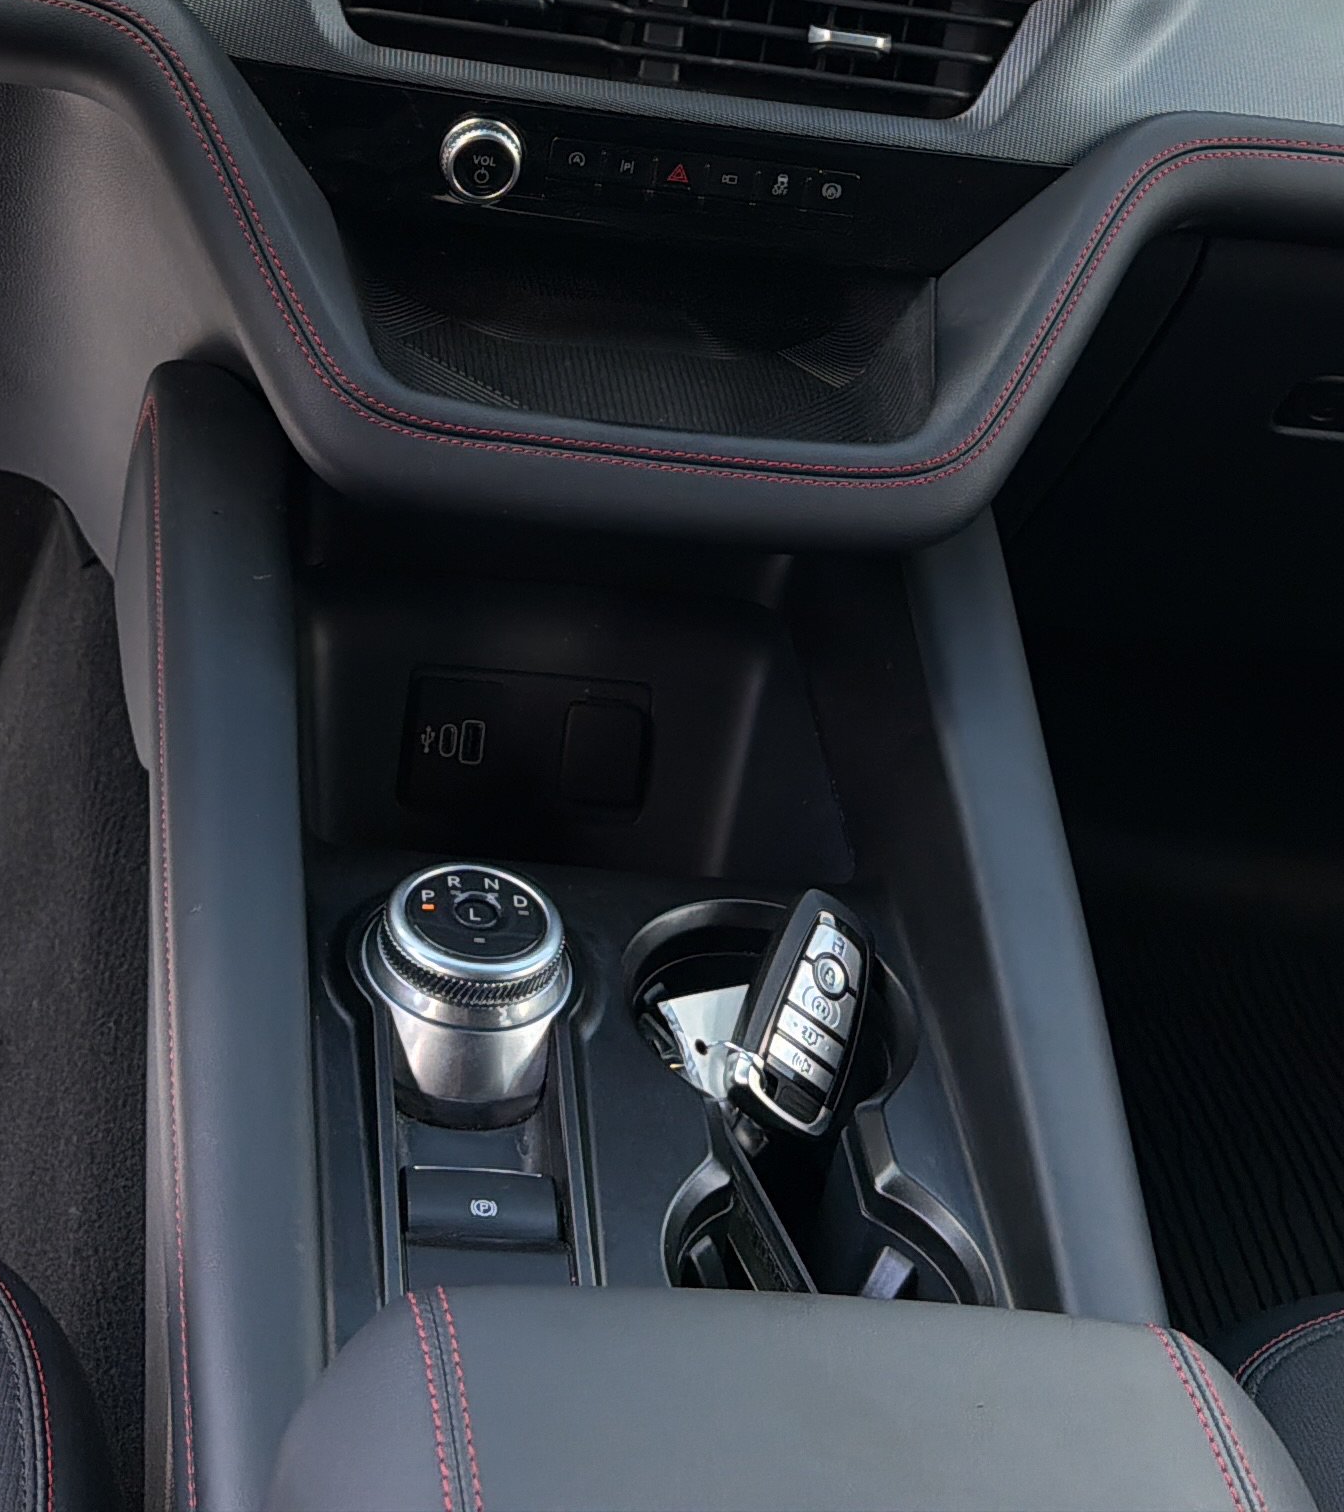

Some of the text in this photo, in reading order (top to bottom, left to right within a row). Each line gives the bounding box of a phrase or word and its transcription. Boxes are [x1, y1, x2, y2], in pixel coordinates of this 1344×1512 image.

[472, 153, 497, 167] VOL
[421, 875, 528, 908] P R N D
[469, 907, 481, 921] L
